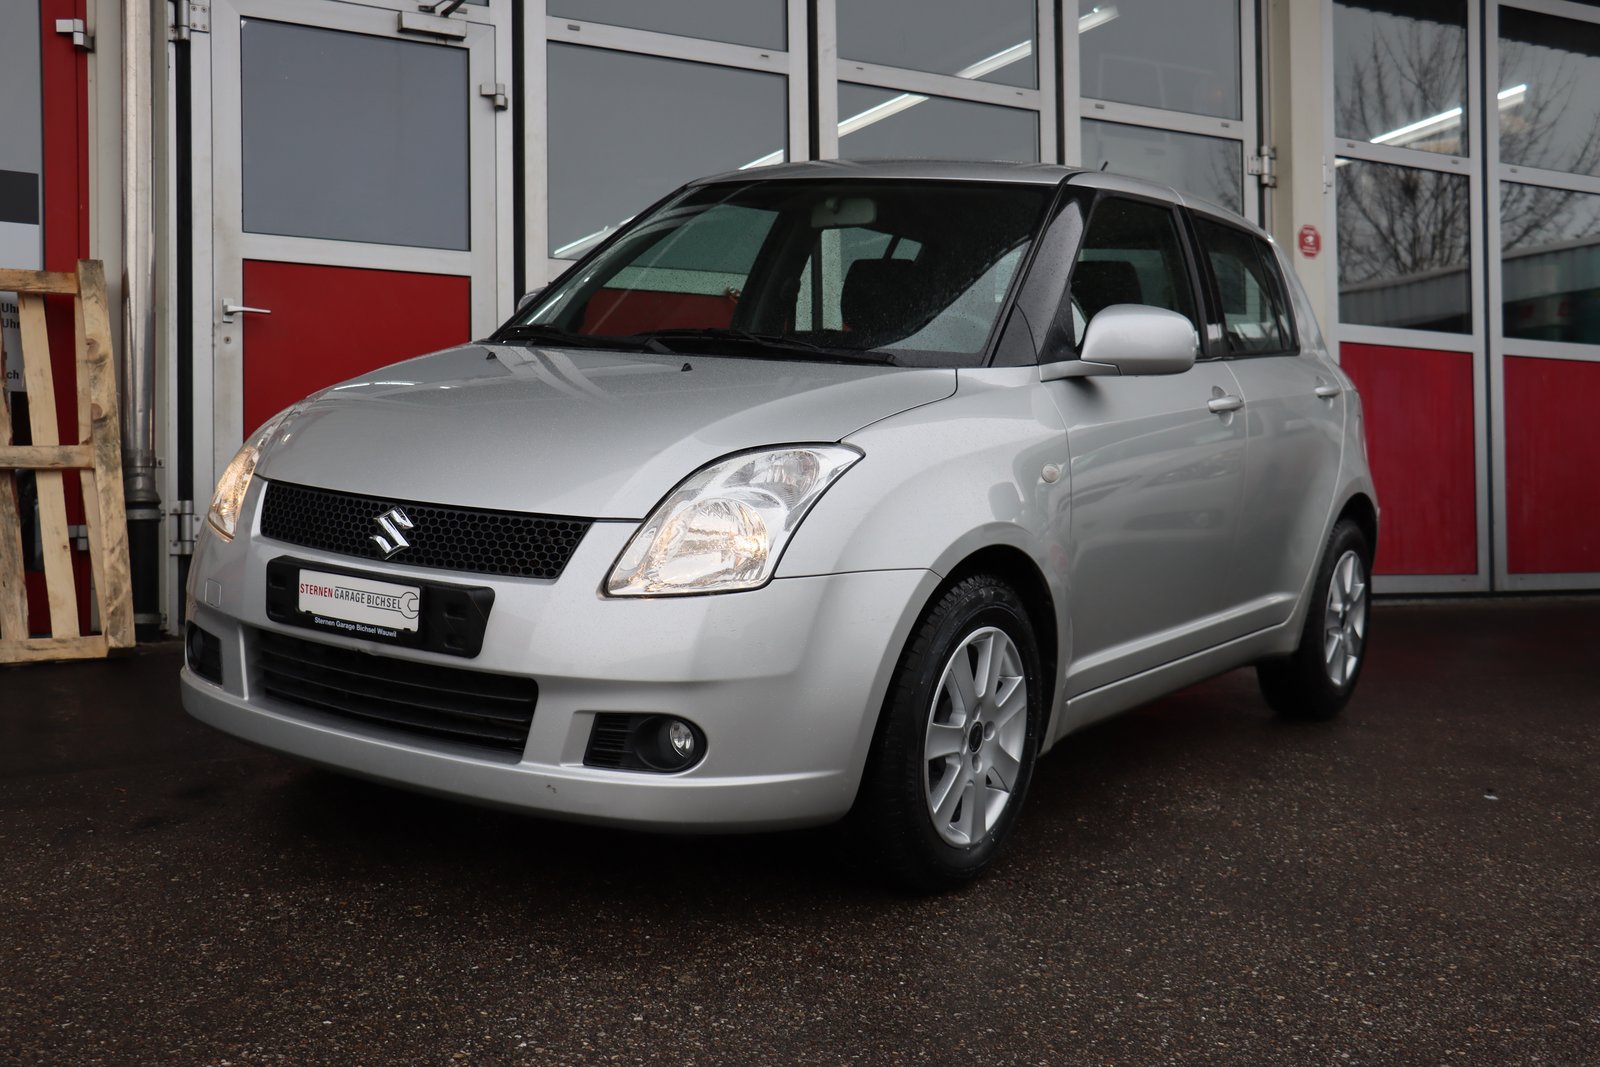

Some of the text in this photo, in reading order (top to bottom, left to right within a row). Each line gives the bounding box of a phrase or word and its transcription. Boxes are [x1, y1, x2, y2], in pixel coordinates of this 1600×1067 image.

[300, 583, 402, 609] STERNEN GARAGE BICHSEL
[314, 616, 397, 638] Sternen Garage Bichsel Wauwil
